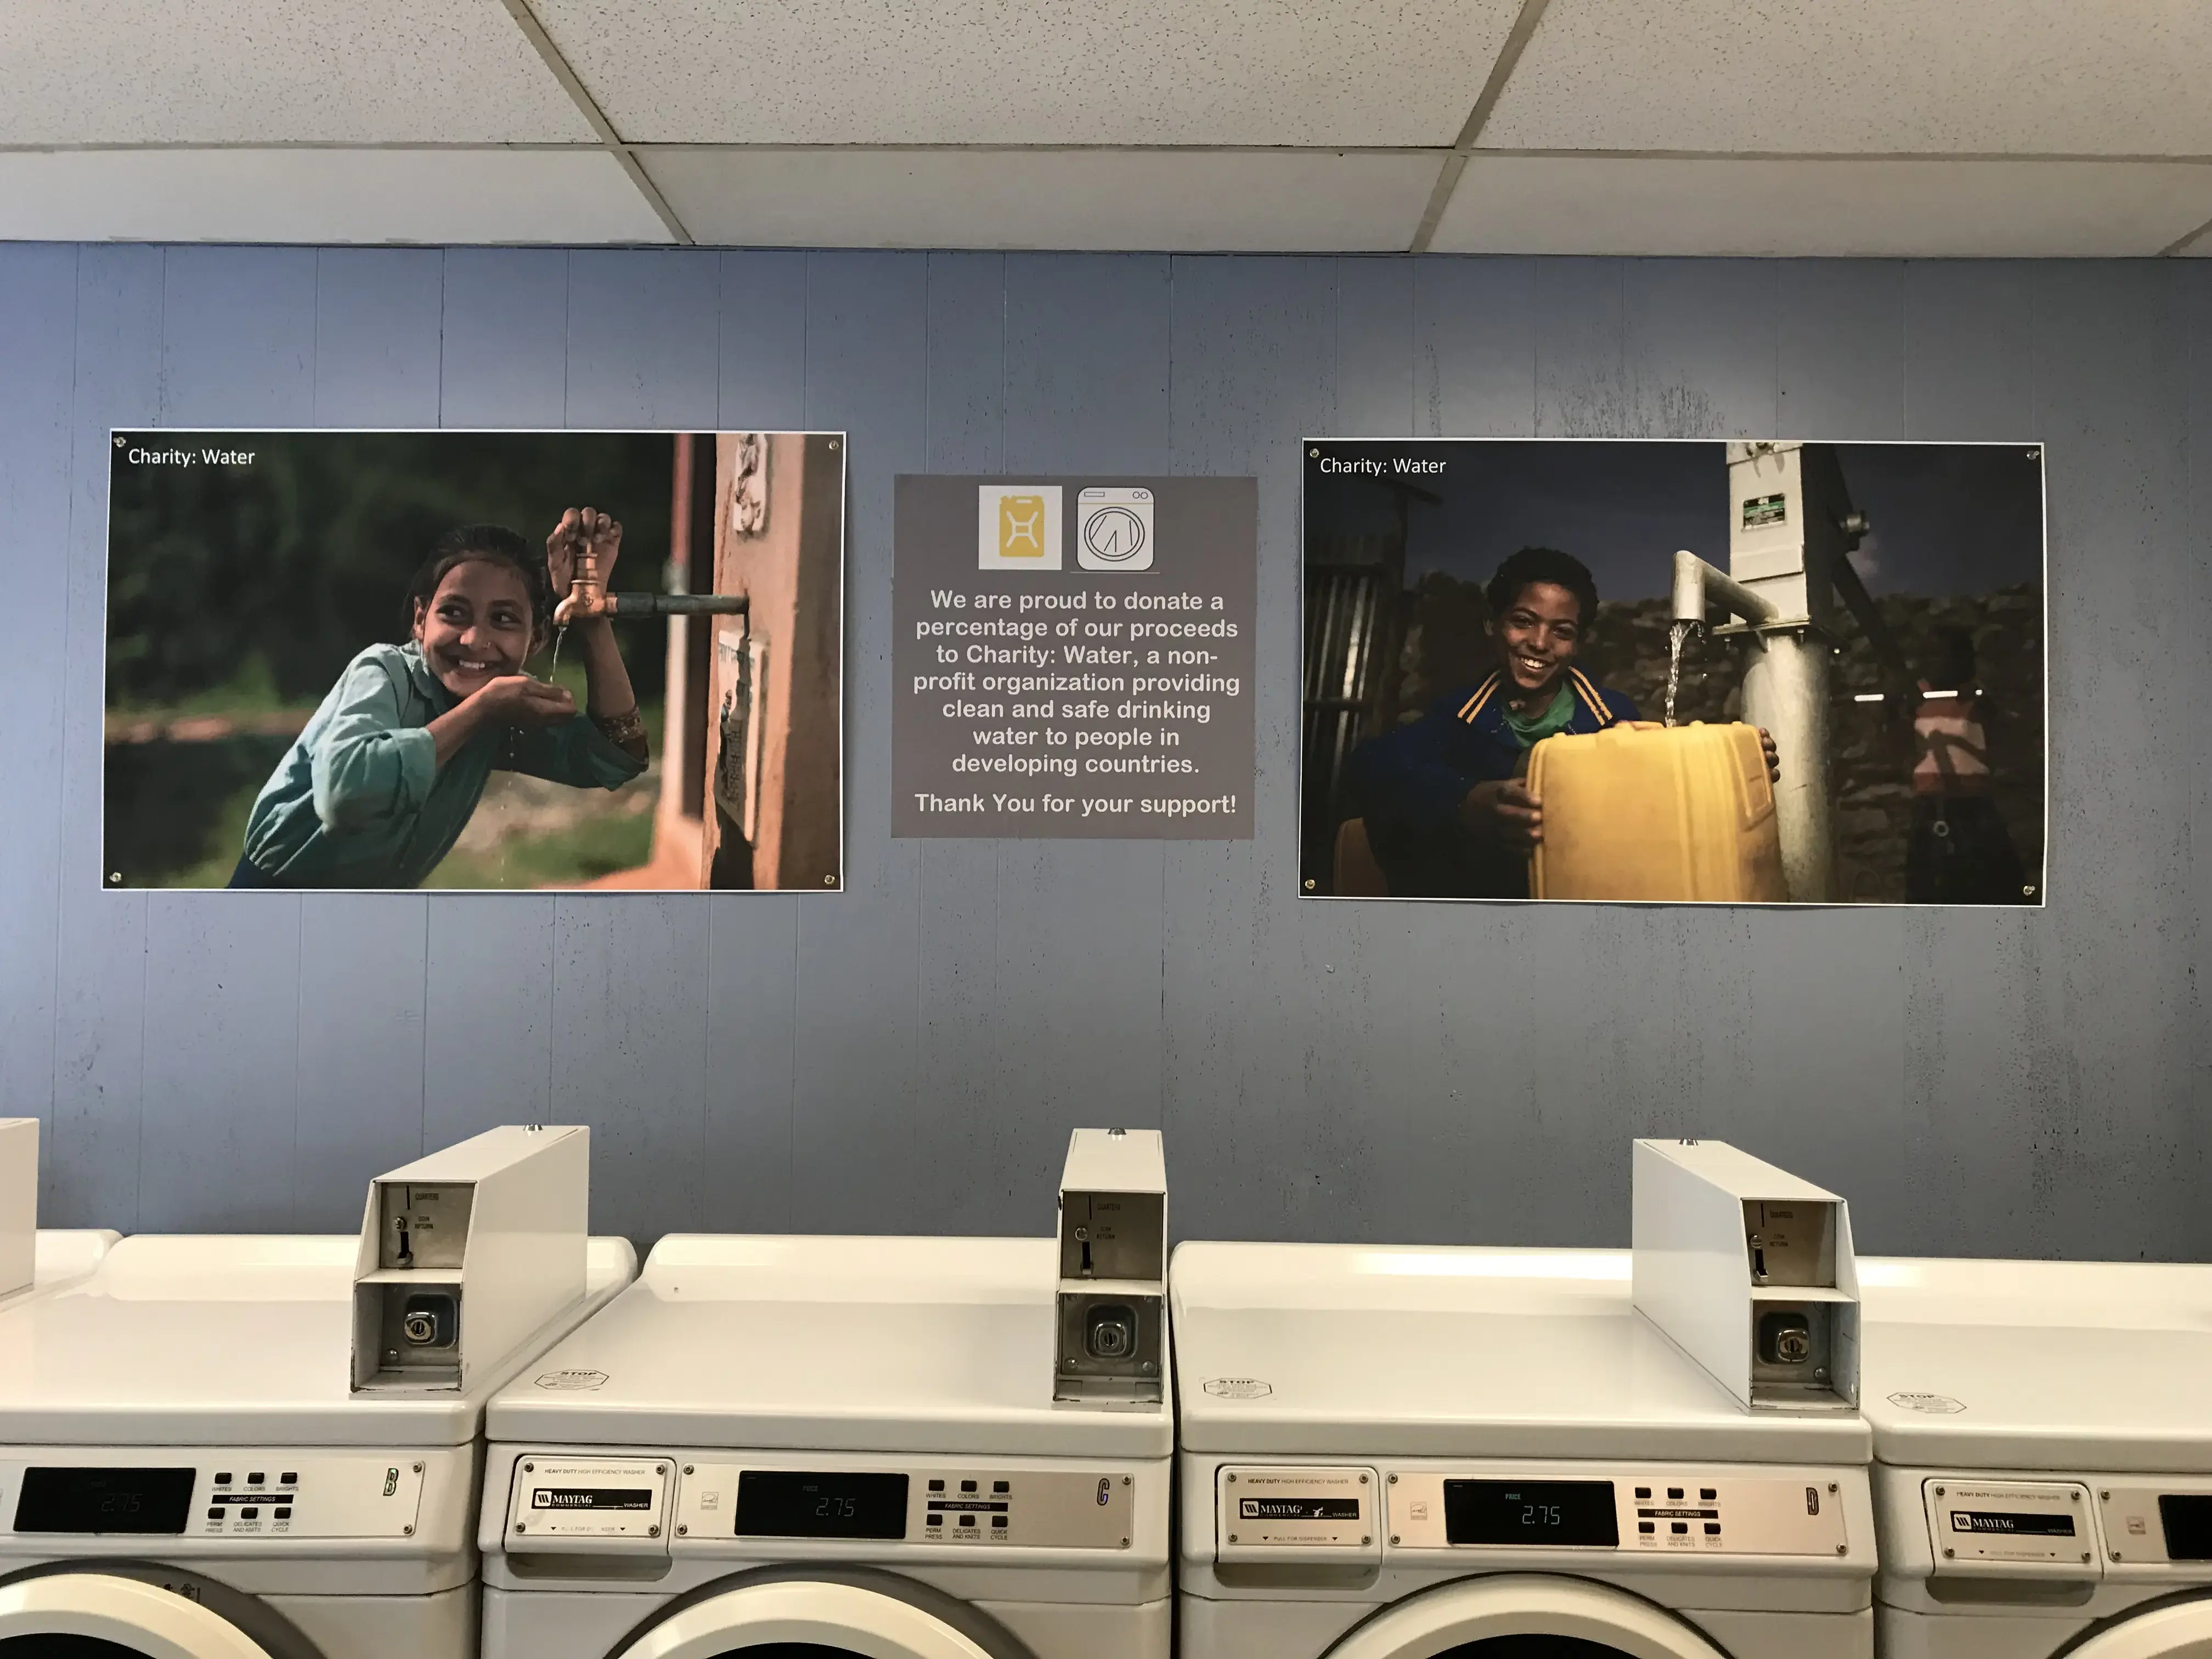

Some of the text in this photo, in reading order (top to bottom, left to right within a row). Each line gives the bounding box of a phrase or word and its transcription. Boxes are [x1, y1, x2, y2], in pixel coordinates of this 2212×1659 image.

[129, 447, 256, 468] Charity: Water
[1321, 457, 1447, 477] Charity: Water
[930, 590, 1223, 613] We are proud to donate a
[917, 618, 1238, 641] percentage of our proceeds
[936, 645, 1218, 668] to Charity: Water, a non-
[914, 672, 1239, 696] profit organization providing
[943, 699, 1210, 724] clean and safe drinking
[973, 727, 1179, 751] water to people in
[952, 753, 1199, 777] developing countries.
[914, 793, 1235, 817] Thank You for your support!
[383, 1468, 399, 1496] B
[1096, 1478, 1110, 1506] C
[552, 1495, 592, 1504] MAYTAG
[815, 1497, 856, 1516] 2.75
[1260, 1505, 1300, 1513] MAYTAG
[1806, 1487, 1819, 1516] D
[1522, 1505, 1560, 1525] 2.75
[1973, 1518, 2013, 1528] MAYTAG
